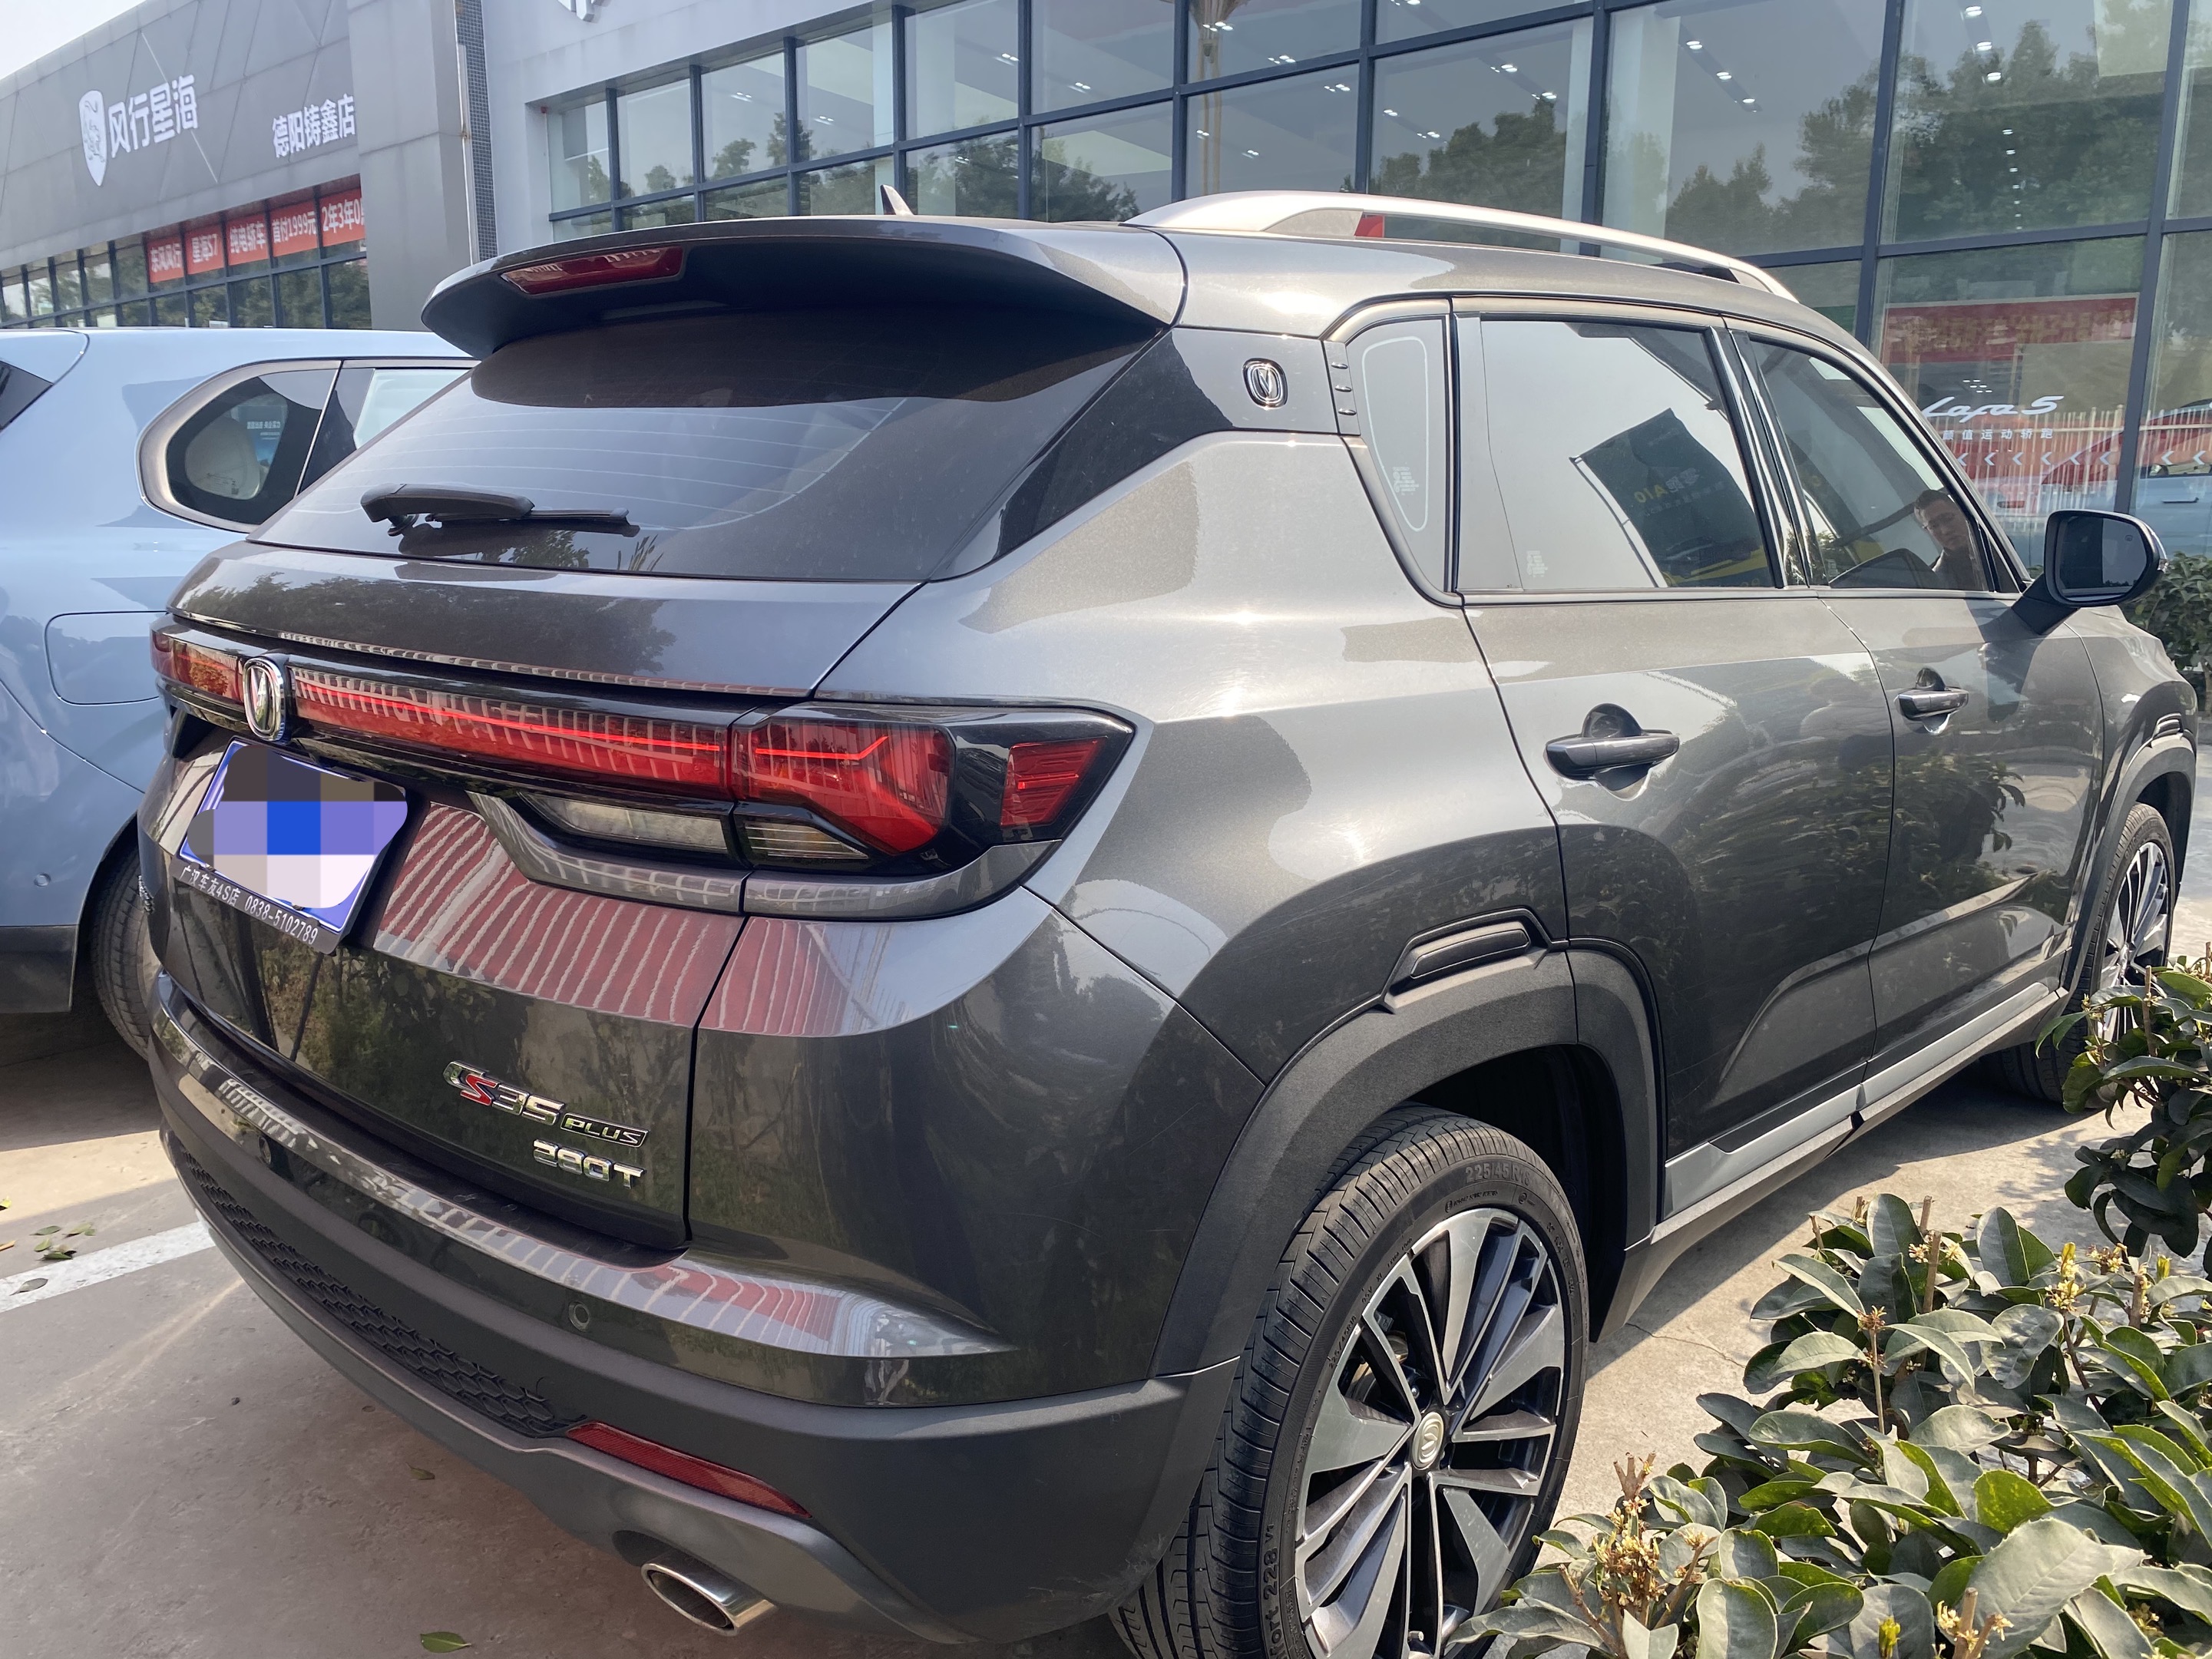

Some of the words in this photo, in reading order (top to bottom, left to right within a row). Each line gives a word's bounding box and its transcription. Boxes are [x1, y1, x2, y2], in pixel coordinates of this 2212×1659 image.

[108, 74, 198, 158] 风行星海
[271, 210, 316, 243] 首付1999元
[179, 865, 242, 907] 广汉车友4S店
[243, 895, 319, 945] 0838-5102789
[443, 1060, 566, 1126] CS35
[563, 1115, 643, 1145] PLUS
[1263, 1547, 1279, 1600] 228
